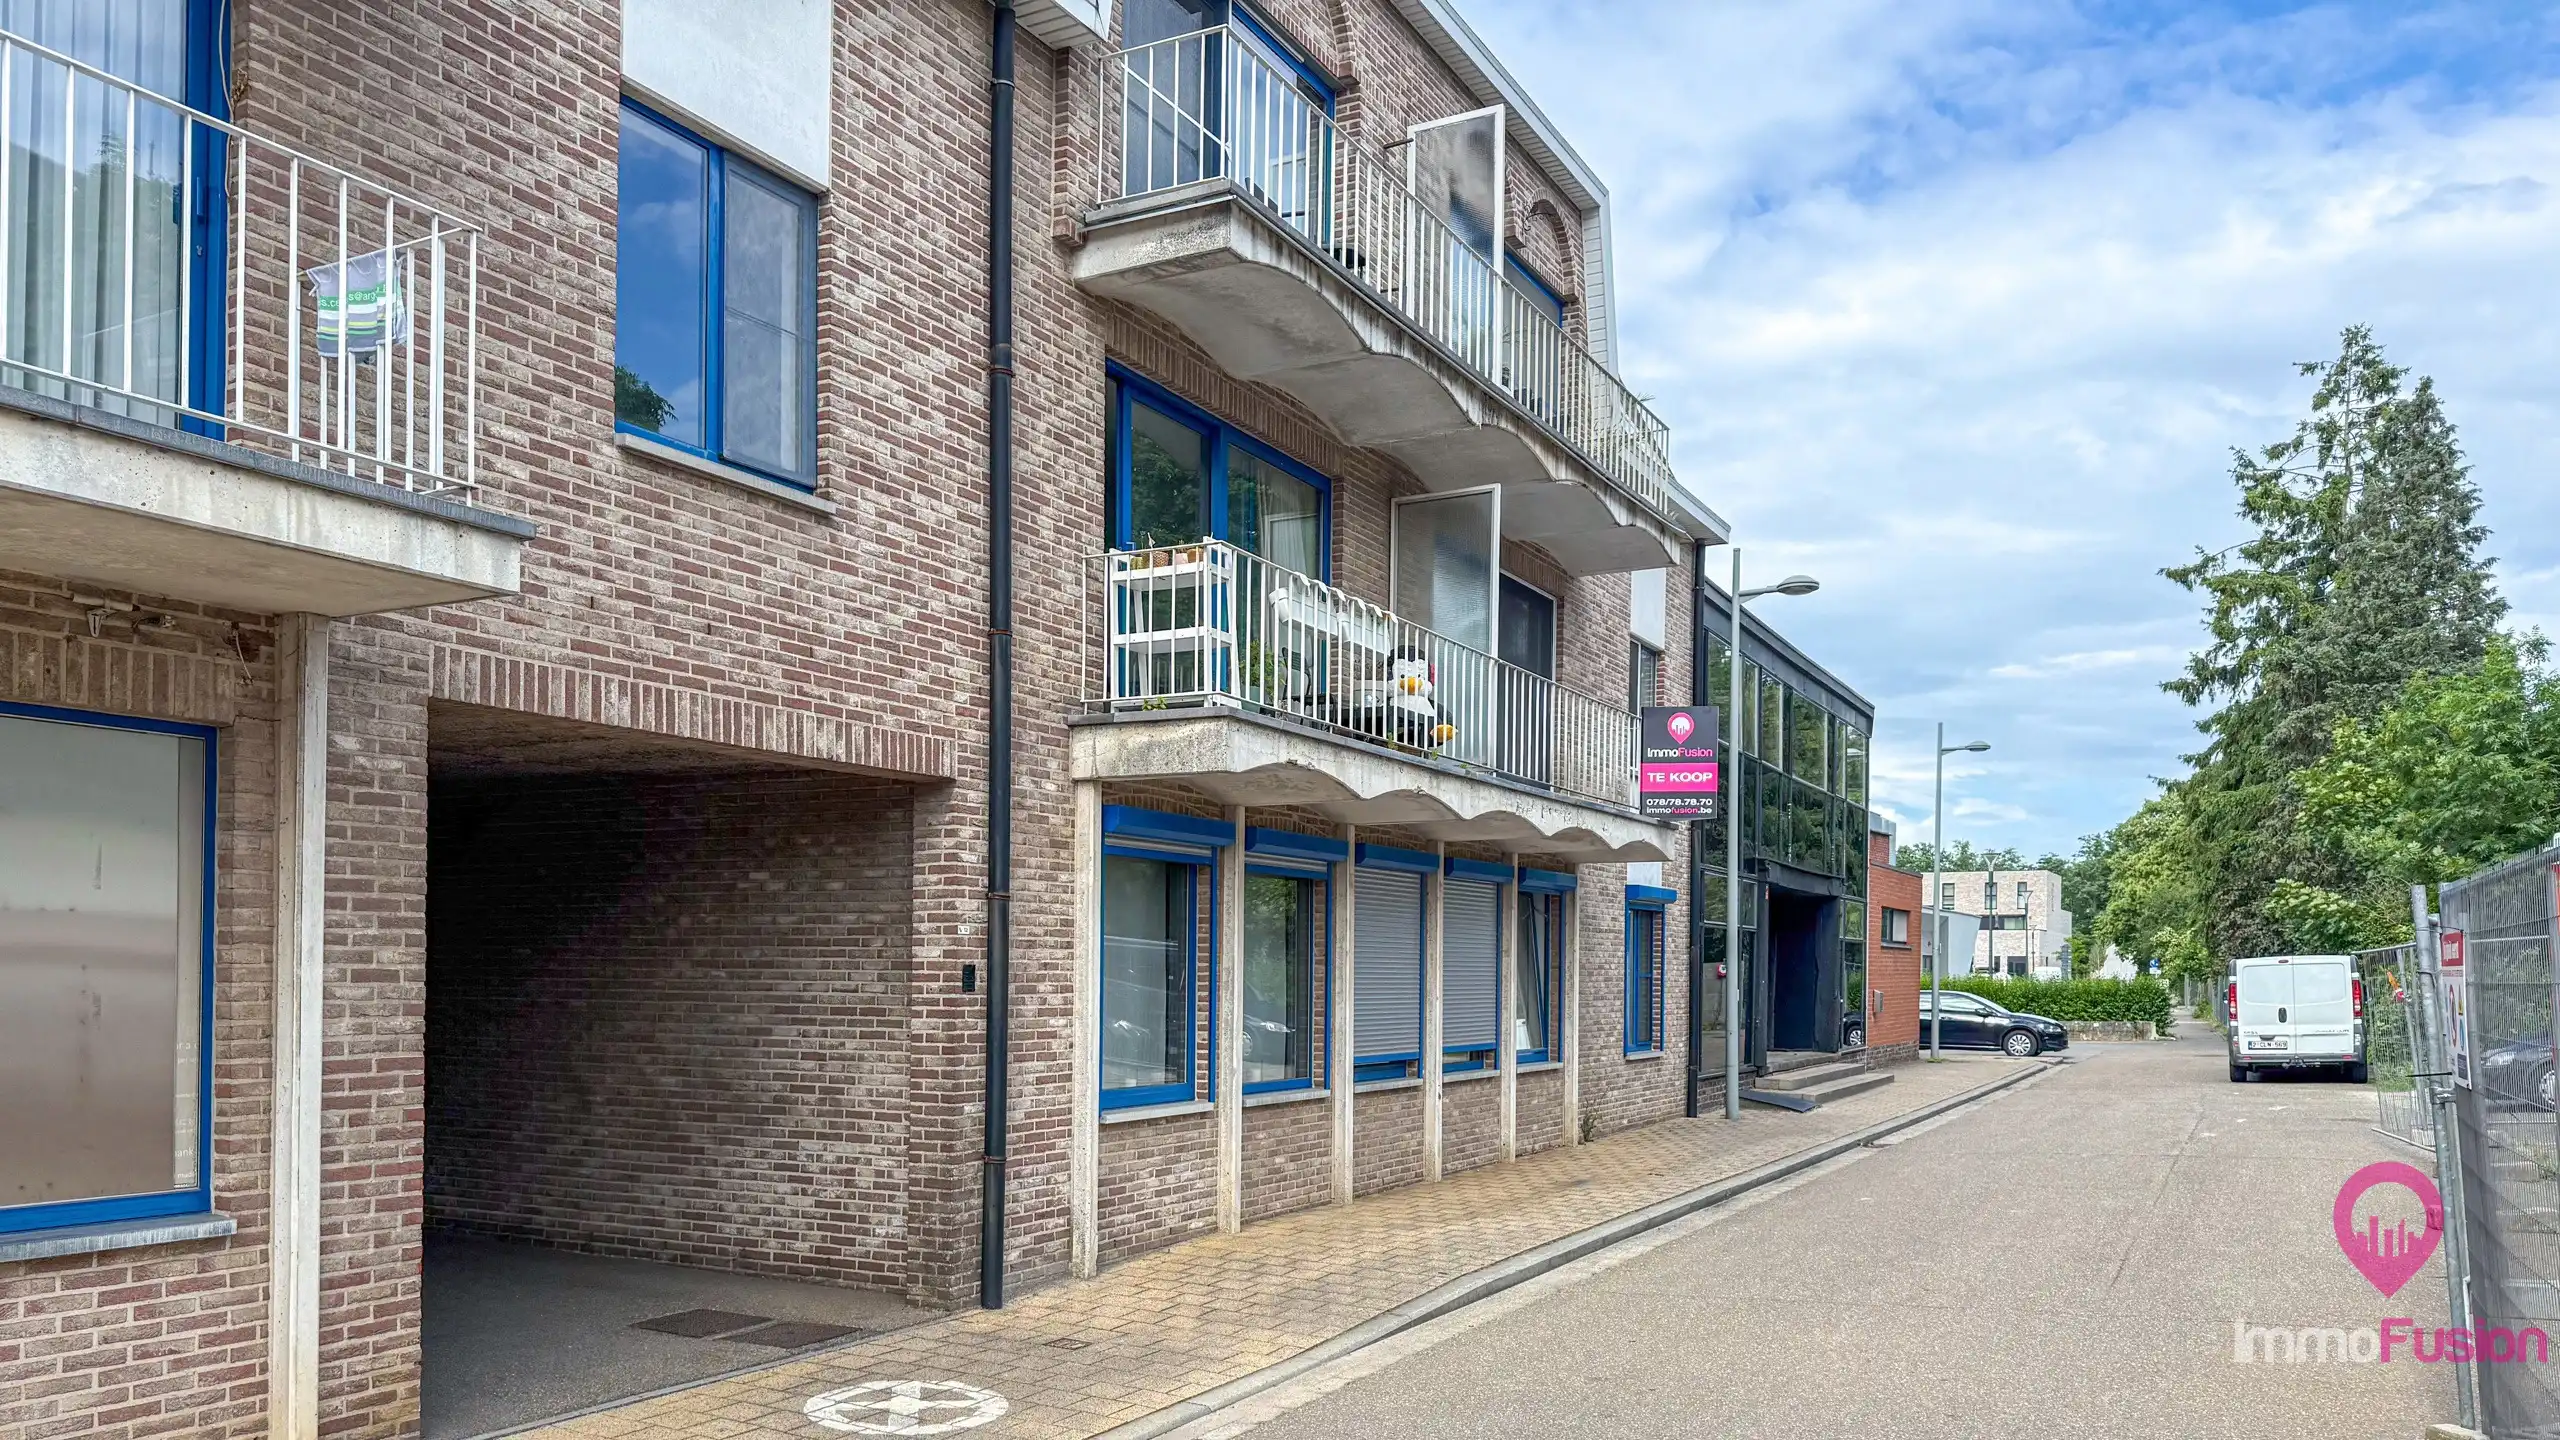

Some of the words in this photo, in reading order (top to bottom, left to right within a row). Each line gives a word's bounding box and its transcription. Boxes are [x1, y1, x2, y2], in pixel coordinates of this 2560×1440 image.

[1647, 747, 1713, 757] ImmoFusion
[1647, 772, 1665, 782] TE
[1670, 772, 1713, 782] KOOP
[1646, 798, 1713, 806] 078/78.78.70
